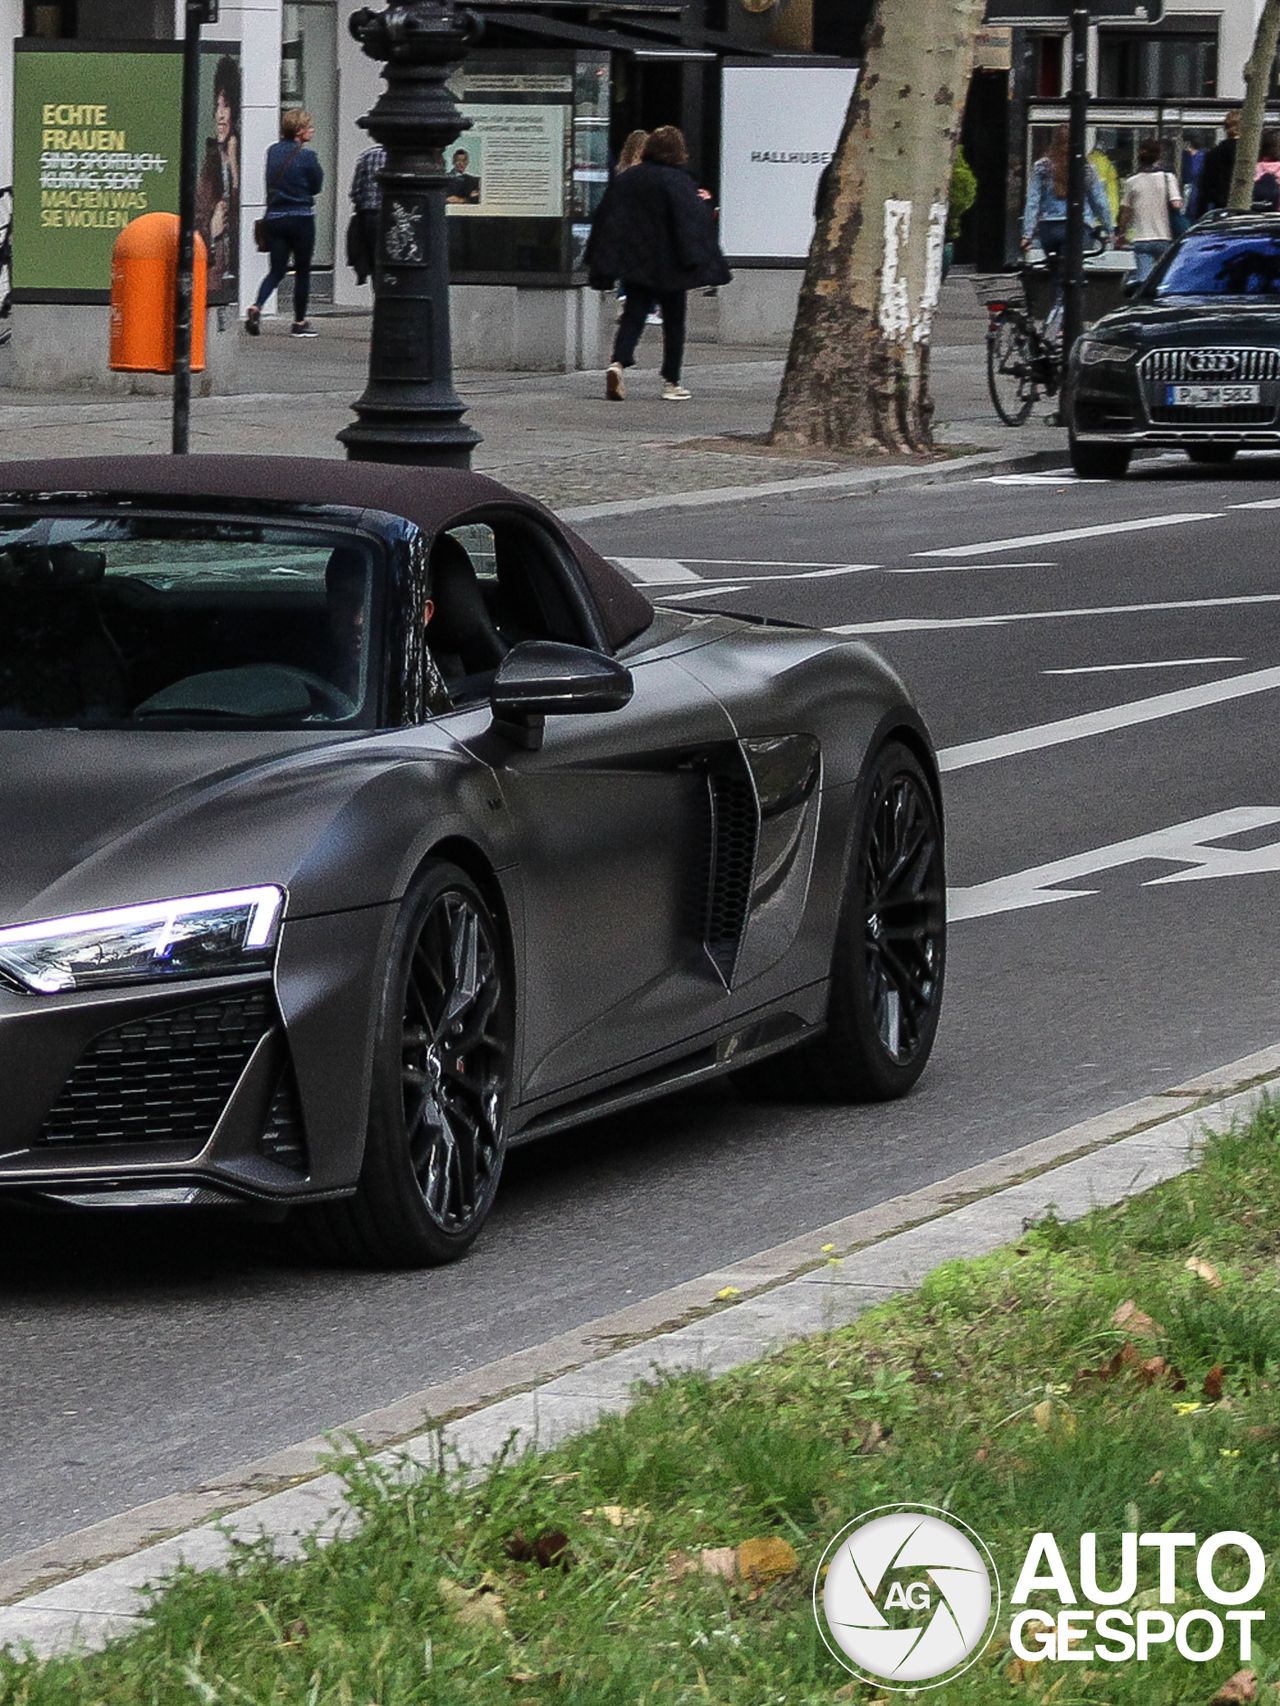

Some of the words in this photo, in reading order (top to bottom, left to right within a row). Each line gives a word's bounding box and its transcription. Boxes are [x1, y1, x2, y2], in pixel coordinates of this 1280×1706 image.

[42, 104, 107, 125] ECHTE
[42, 129, 125, 150] FRAUEN
[751, 151, 833, 164] HALLHUBE
[41, 191, 113, 208] MACHEN
[114, 191, 147, 209] WAS
[41, 209, 63, 227] SIE
